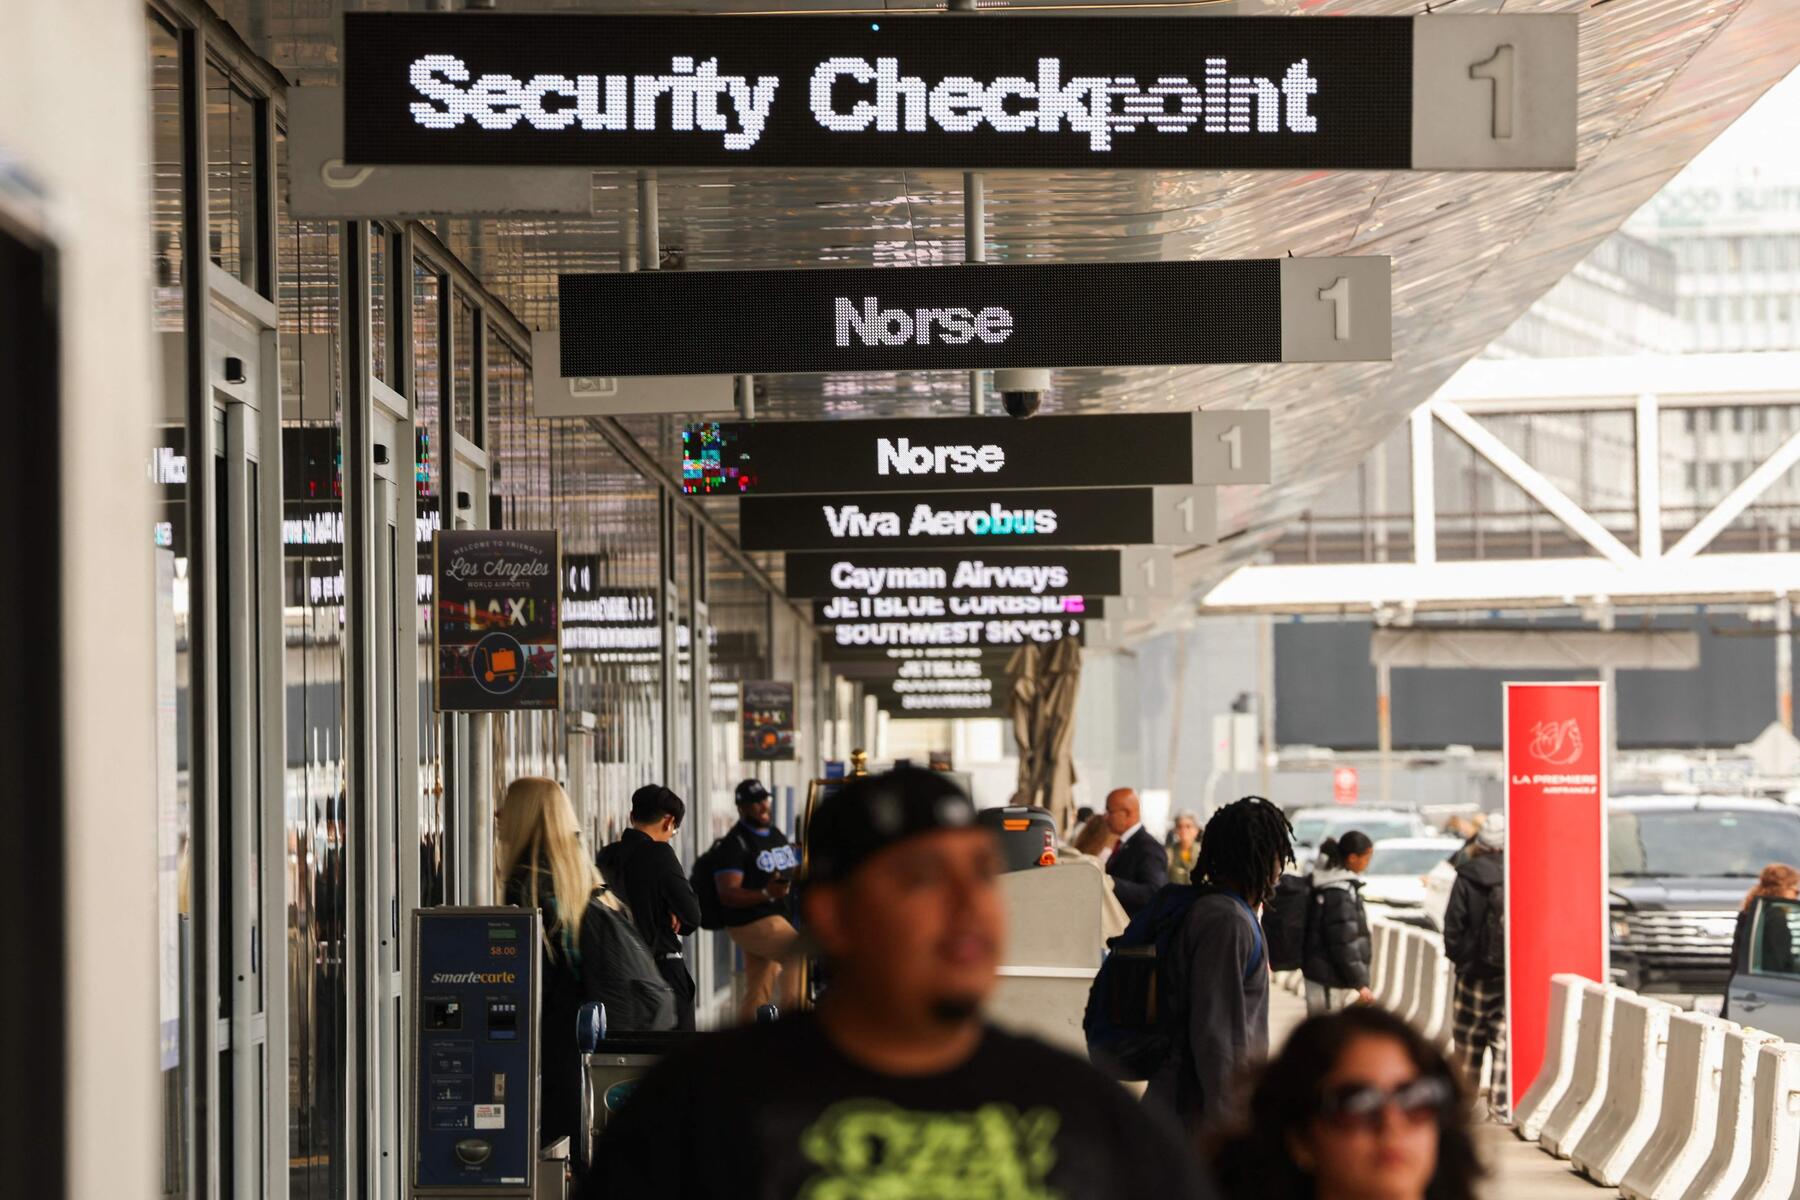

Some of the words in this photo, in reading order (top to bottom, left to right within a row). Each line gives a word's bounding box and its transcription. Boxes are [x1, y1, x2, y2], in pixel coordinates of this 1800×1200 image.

[409, 54, 780, 151] Security
[809, 56, 1318, 153] Checkpoint
[1468, 43, 1514, 139] 1
[834, 297, 1014, 347] Norse
[1318, 276, 1349, 341] 1
[877, 437, 1006, 476] Norse
[1218, 425, 1242, 471] 1
[823, 505, 901, 538] Viva
[907, 502, 1058, 536] Aerobus
[1175, 496, 1195, 533] 1
[445, 556, 479, 582] Los
[482, 557, 551, 583] Angeles
[830, 561, 947, 595] Cayman
[952, 560, 1069, 593] Airways
[824, 596, 946, 618] JETBLUE
[835, 621, 984, 645] SOUTHWEST
[490, 946, 517, 956] $8.00
[431, 971, 516, 984] smartecarte
